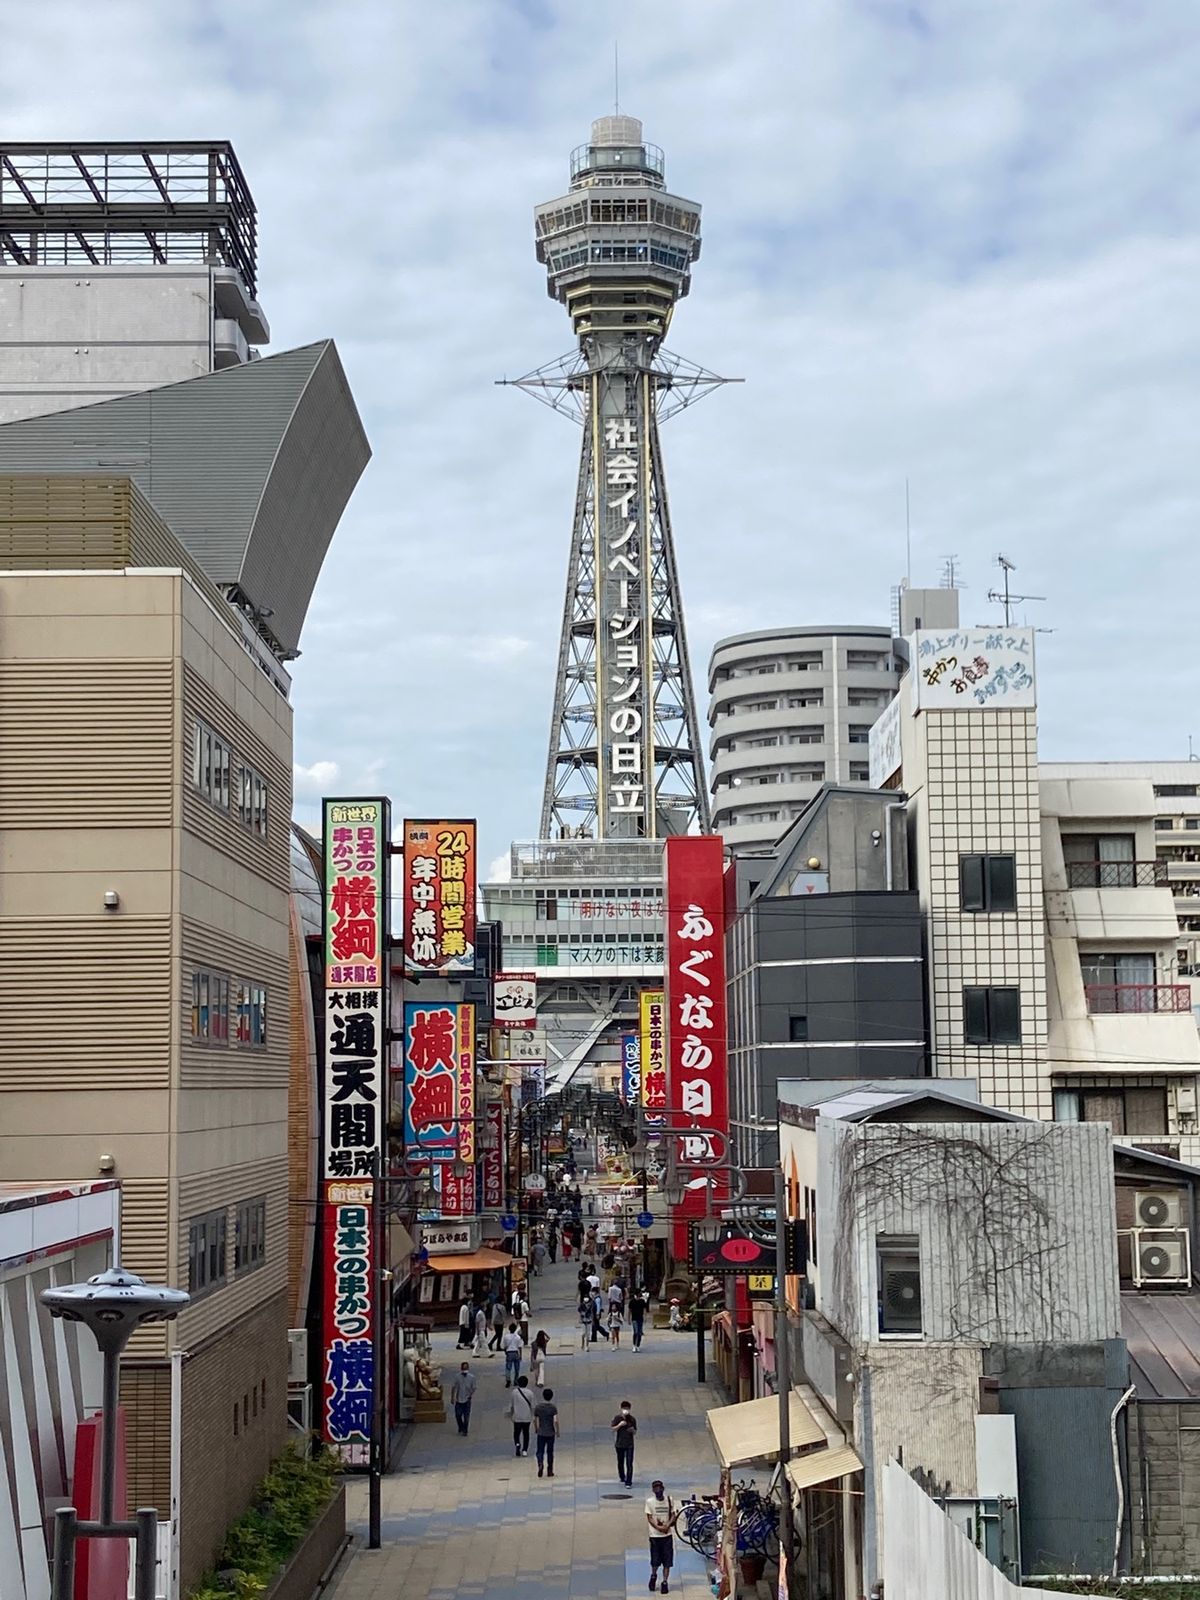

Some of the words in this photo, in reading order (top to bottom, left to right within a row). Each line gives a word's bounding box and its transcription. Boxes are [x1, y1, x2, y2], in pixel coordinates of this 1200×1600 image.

[605, 417, 643, 813] 社会イノベーションの日立
[331, 806, 376, 822] 新世界
[333, 827, 353, 872] 串かつ
[356, 827, 376, 872] 日本一の
[330, 876, 376, 960] 横綱
[411, 856, 437, 961] 年中無休
[437, 831, 470, 956] 24時間営業
[328, 991, 379, 1009] 大相撲
[331, 966, 376, 983] 通天閣店
[409, 1010, 456, 1134] 横綱
[649, 1005, 662, 1070] 日本一の串かつ
[329, 1012, 378, 1149] 通天閣
[328, 1151, 376, 1177] 場所
[336, 1206, 370, 1336] 日本一の串かつ
[327, 1339, 373, 1442] 横綱
